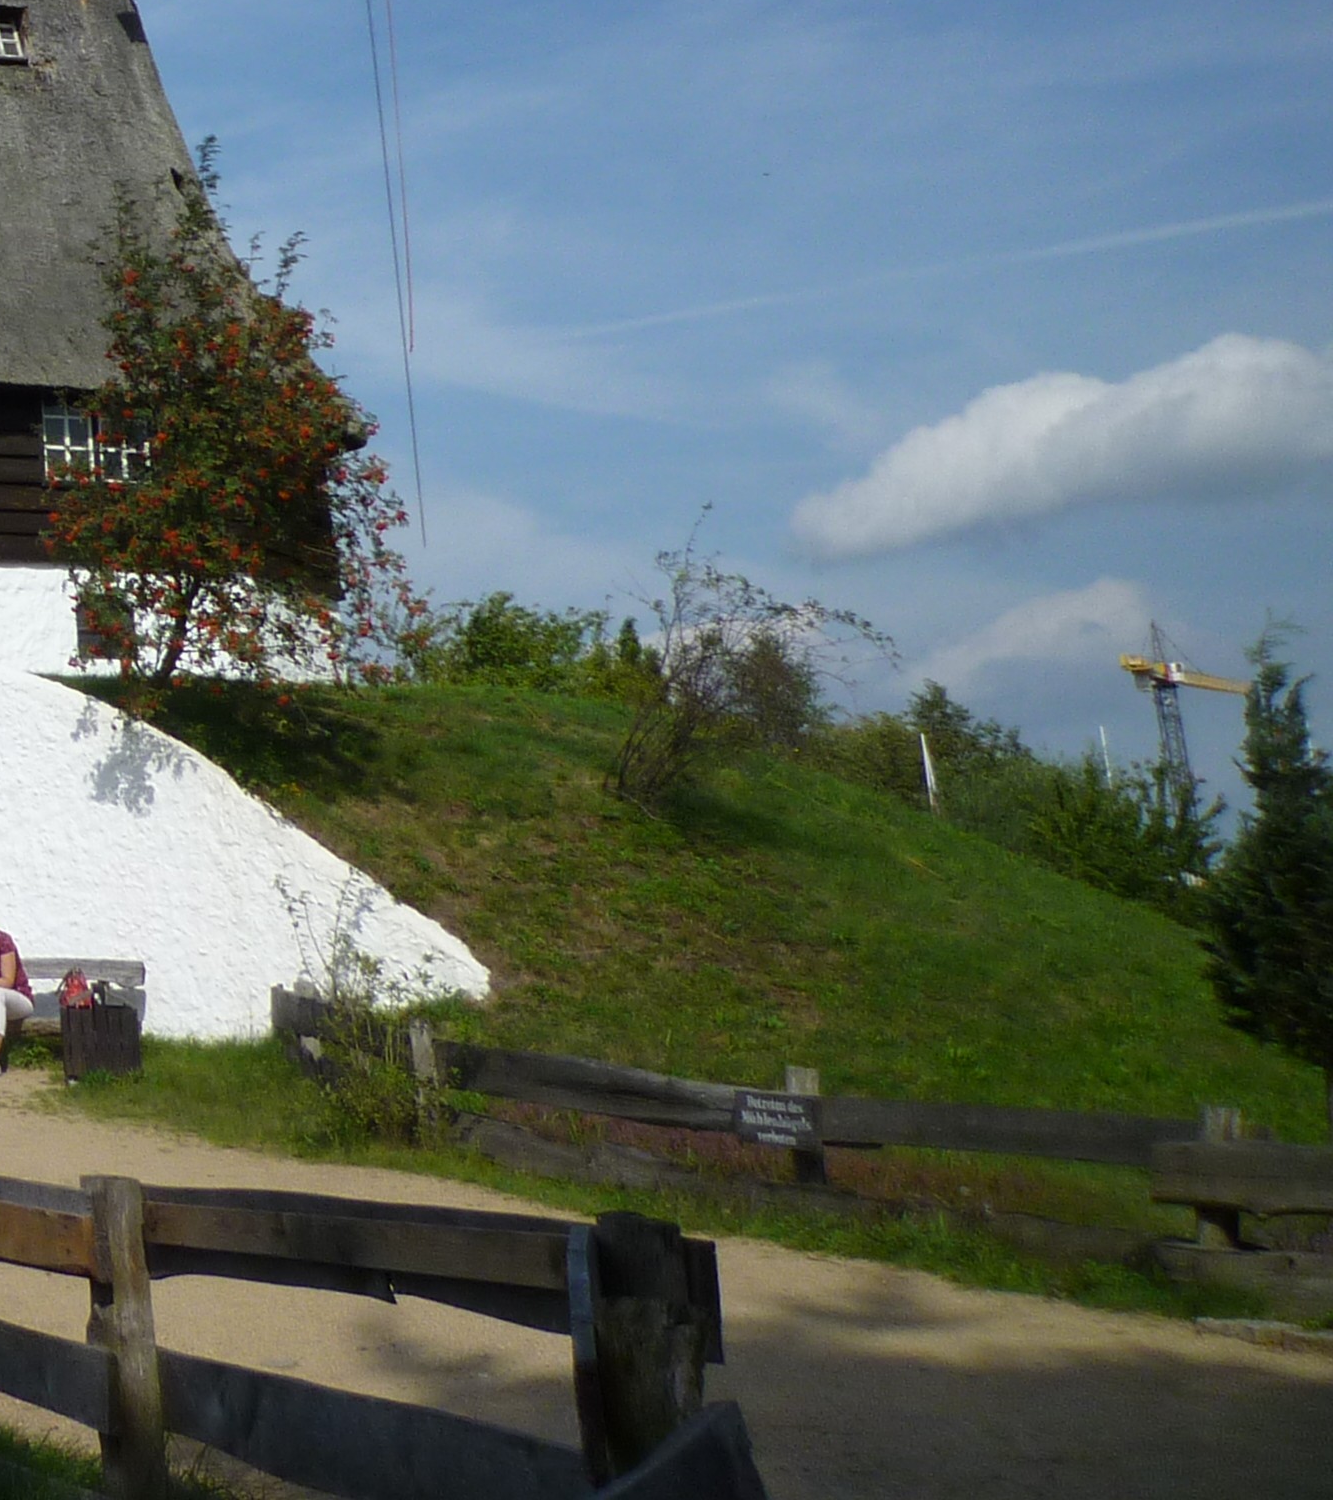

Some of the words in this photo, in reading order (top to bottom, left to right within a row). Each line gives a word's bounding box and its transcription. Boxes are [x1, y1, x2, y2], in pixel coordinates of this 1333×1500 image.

[746, 1095, 786, 1112] Betreten
[787, 1100, 804, 1114] des
[757, 1130, 797, 1146] verboten
